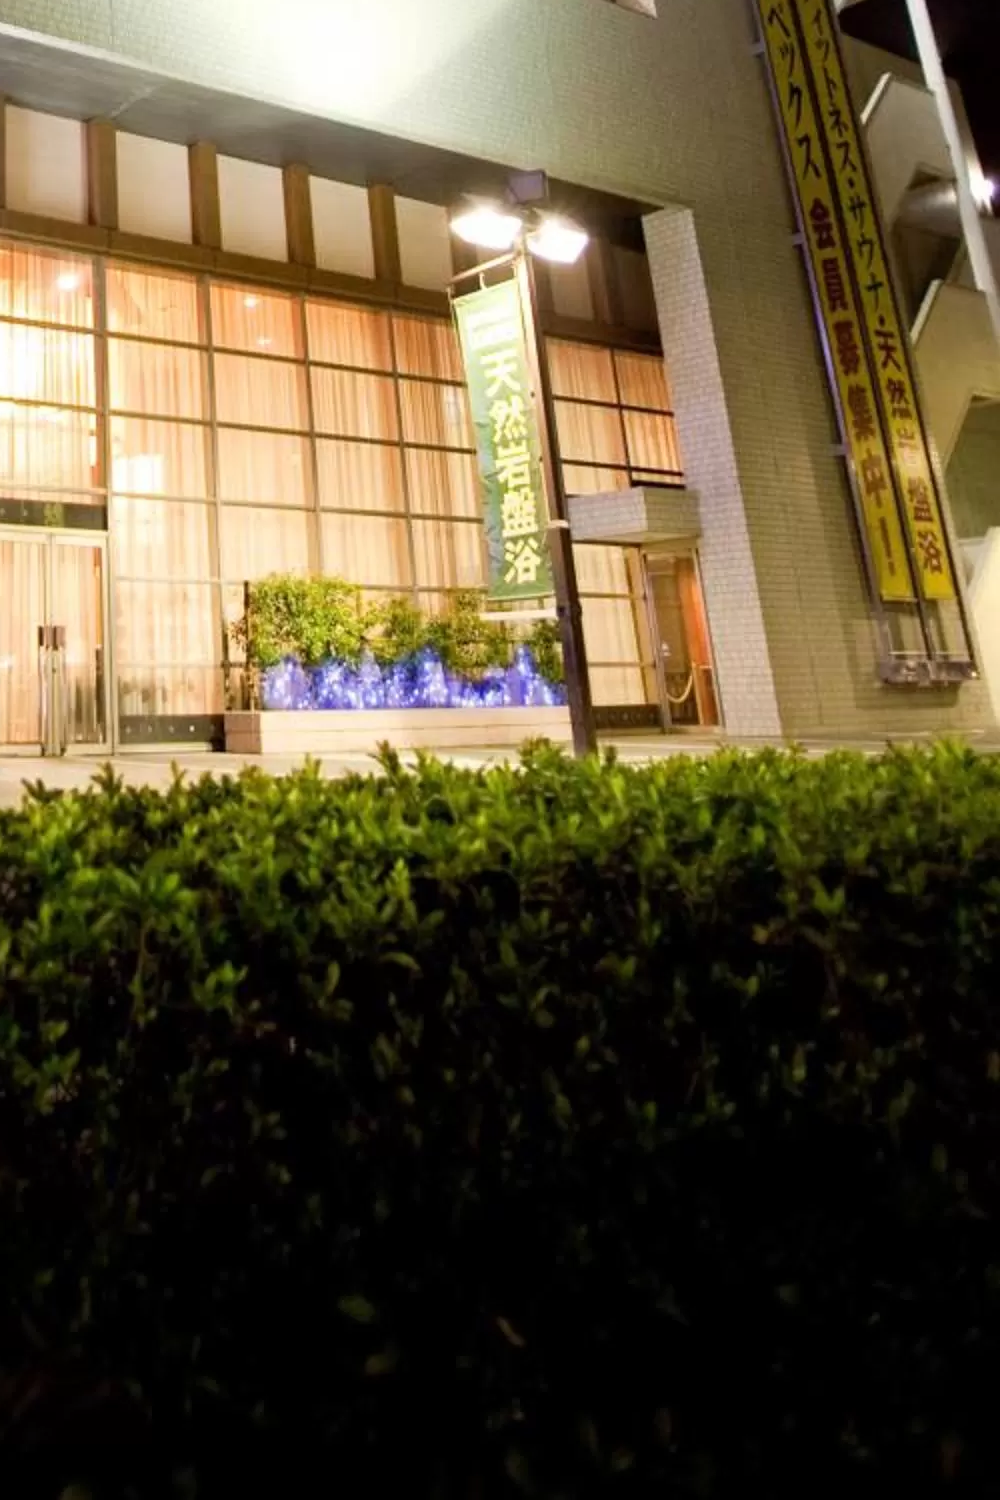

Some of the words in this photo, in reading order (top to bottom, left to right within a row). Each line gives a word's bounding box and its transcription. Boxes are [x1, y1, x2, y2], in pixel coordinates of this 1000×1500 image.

[480, 350, 541, 585] 天然岩盤浴
